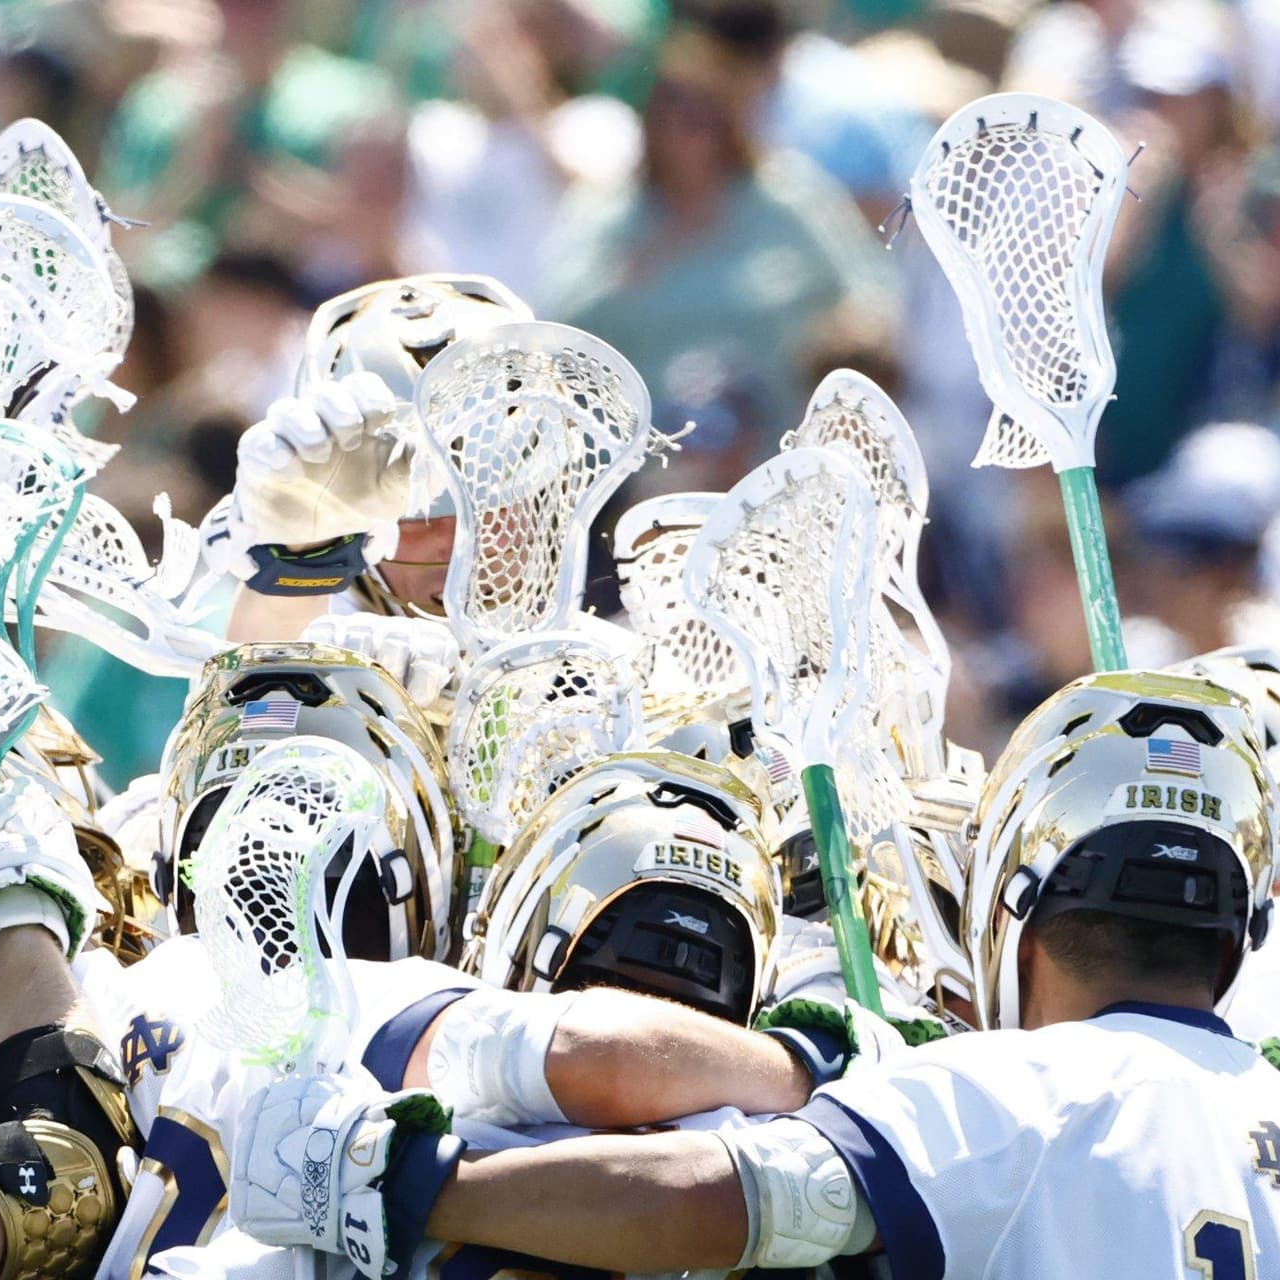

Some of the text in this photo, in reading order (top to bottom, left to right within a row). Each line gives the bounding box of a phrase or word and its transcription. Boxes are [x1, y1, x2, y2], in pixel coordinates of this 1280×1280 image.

[1126, 785, 1221, 821] IRISH
[654, 844, 743, 886] IRISH
[345, 1211, 372, 1267] 12
